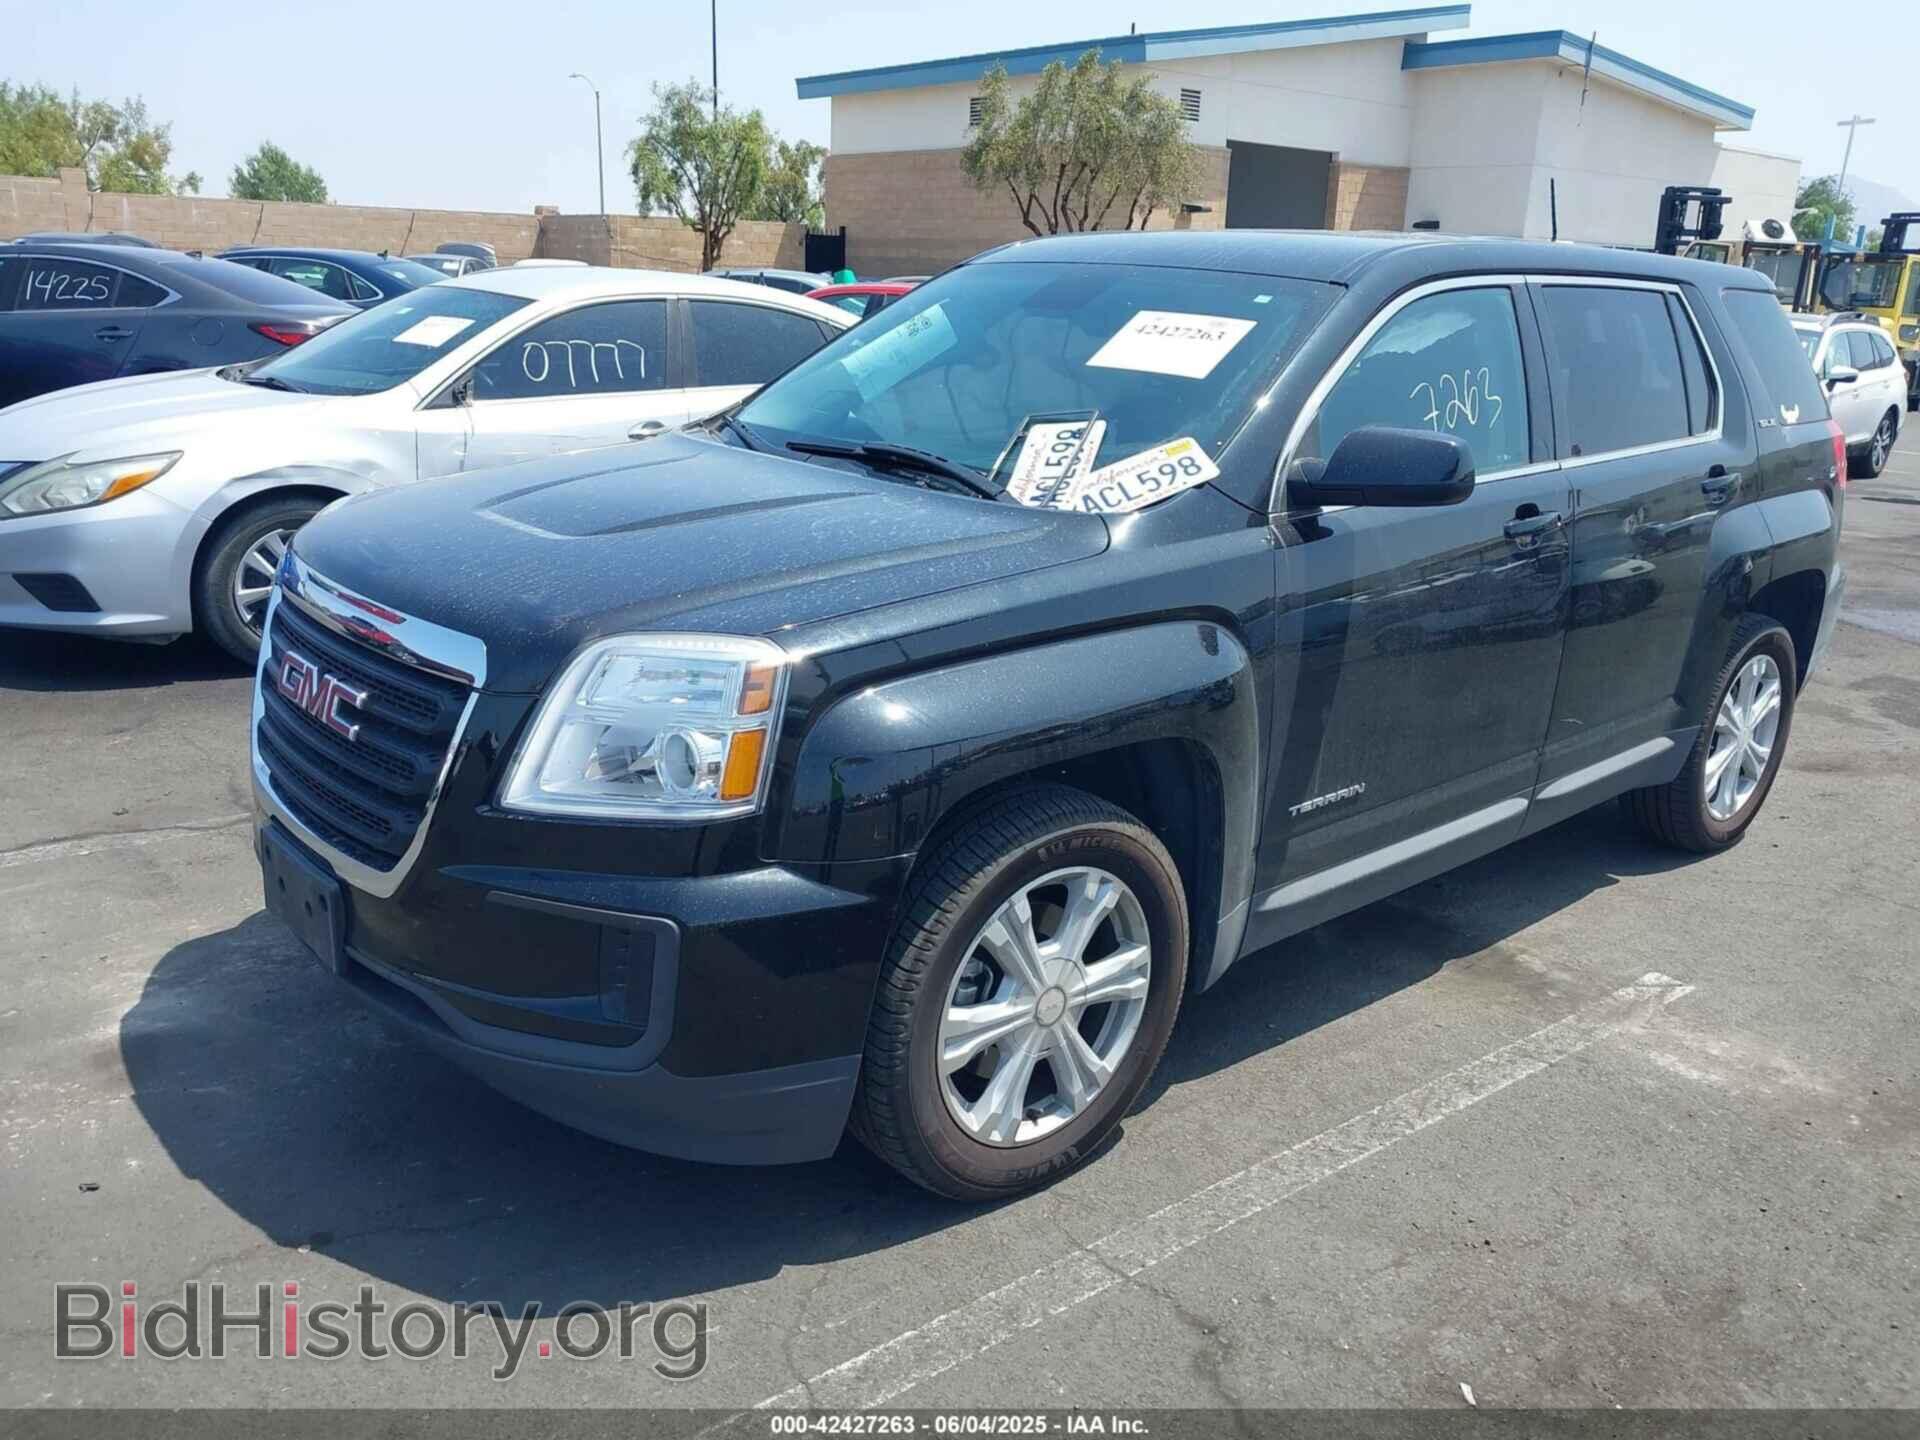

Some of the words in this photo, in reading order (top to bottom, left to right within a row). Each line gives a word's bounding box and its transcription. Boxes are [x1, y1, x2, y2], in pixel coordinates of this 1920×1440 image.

[25, 269, 110, 303] 14225
[522, 339, 645, 388] 07777
[279, 650, 368, 741] GMC
[1288, 782, 1366, 816] TERRAIN
